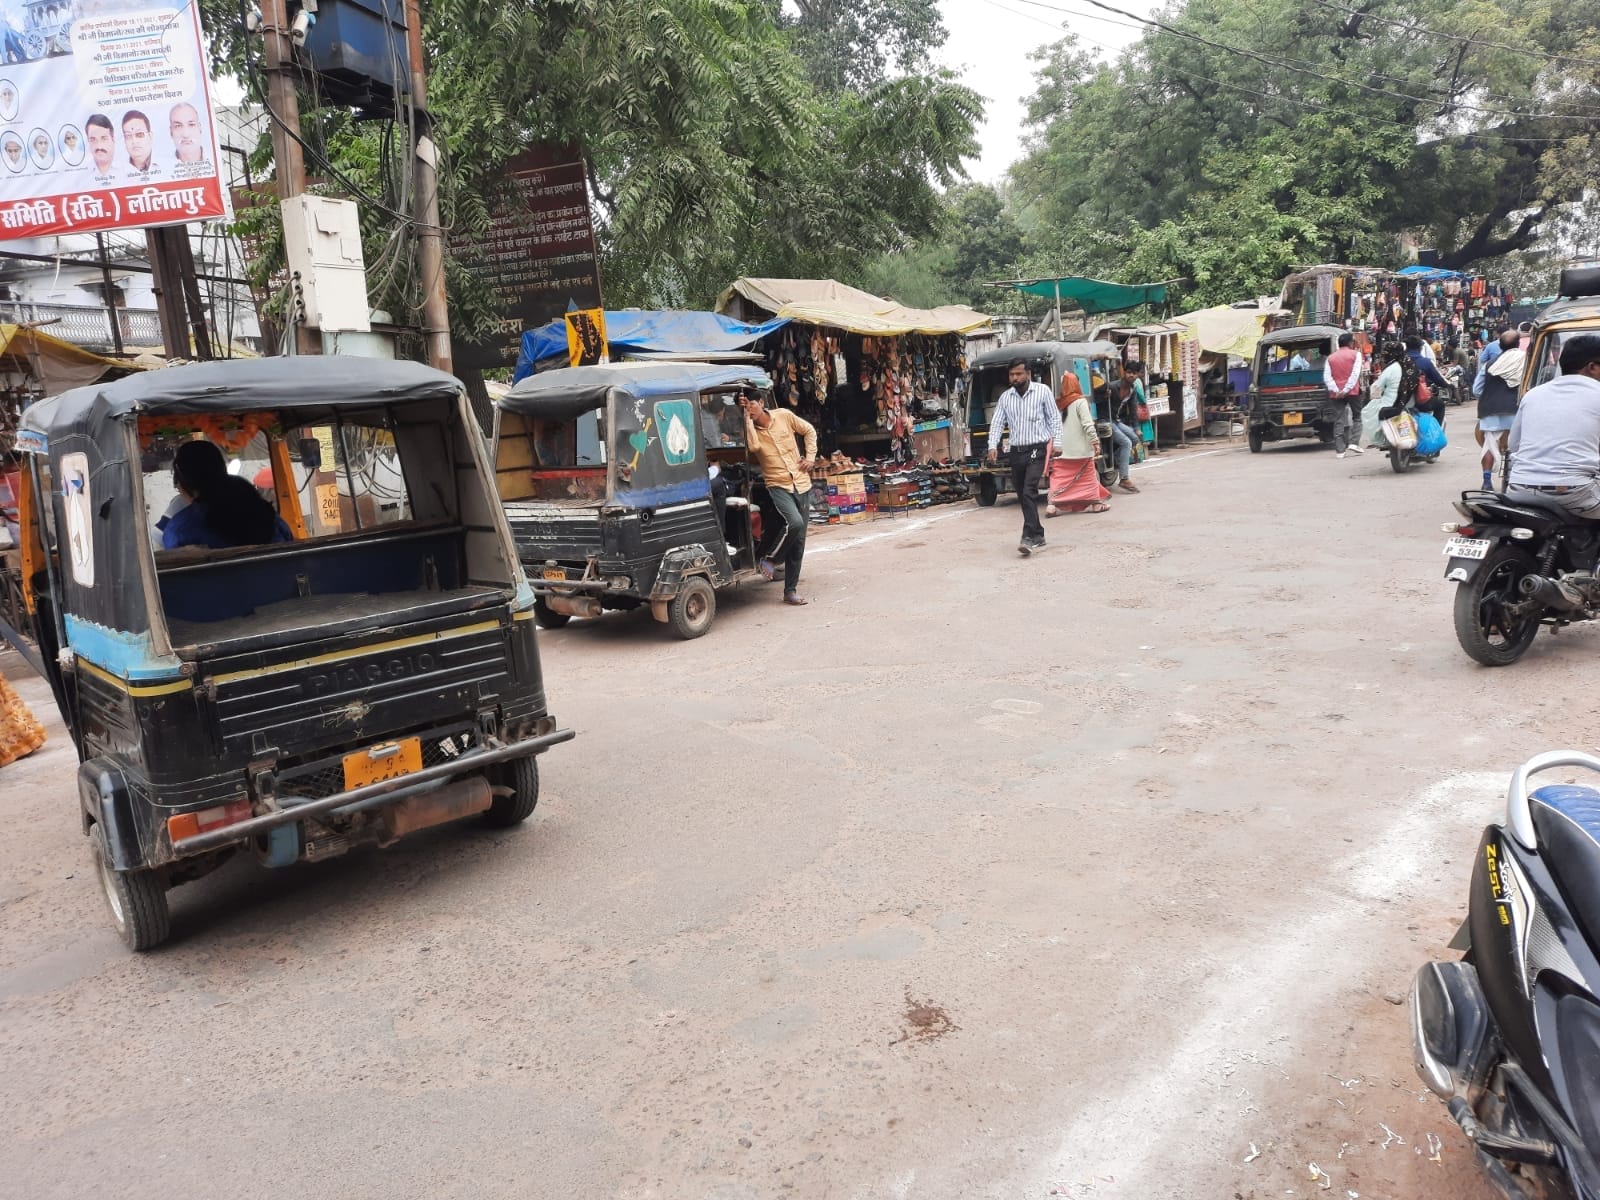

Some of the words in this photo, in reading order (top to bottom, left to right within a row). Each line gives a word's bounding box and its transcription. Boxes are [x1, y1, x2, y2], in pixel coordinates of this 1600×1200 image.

[0, 200, 56, 228] समिति
[125, 186, 206, 215] ललितपुर
[309, 653, 435, 692] PIAGGIO
